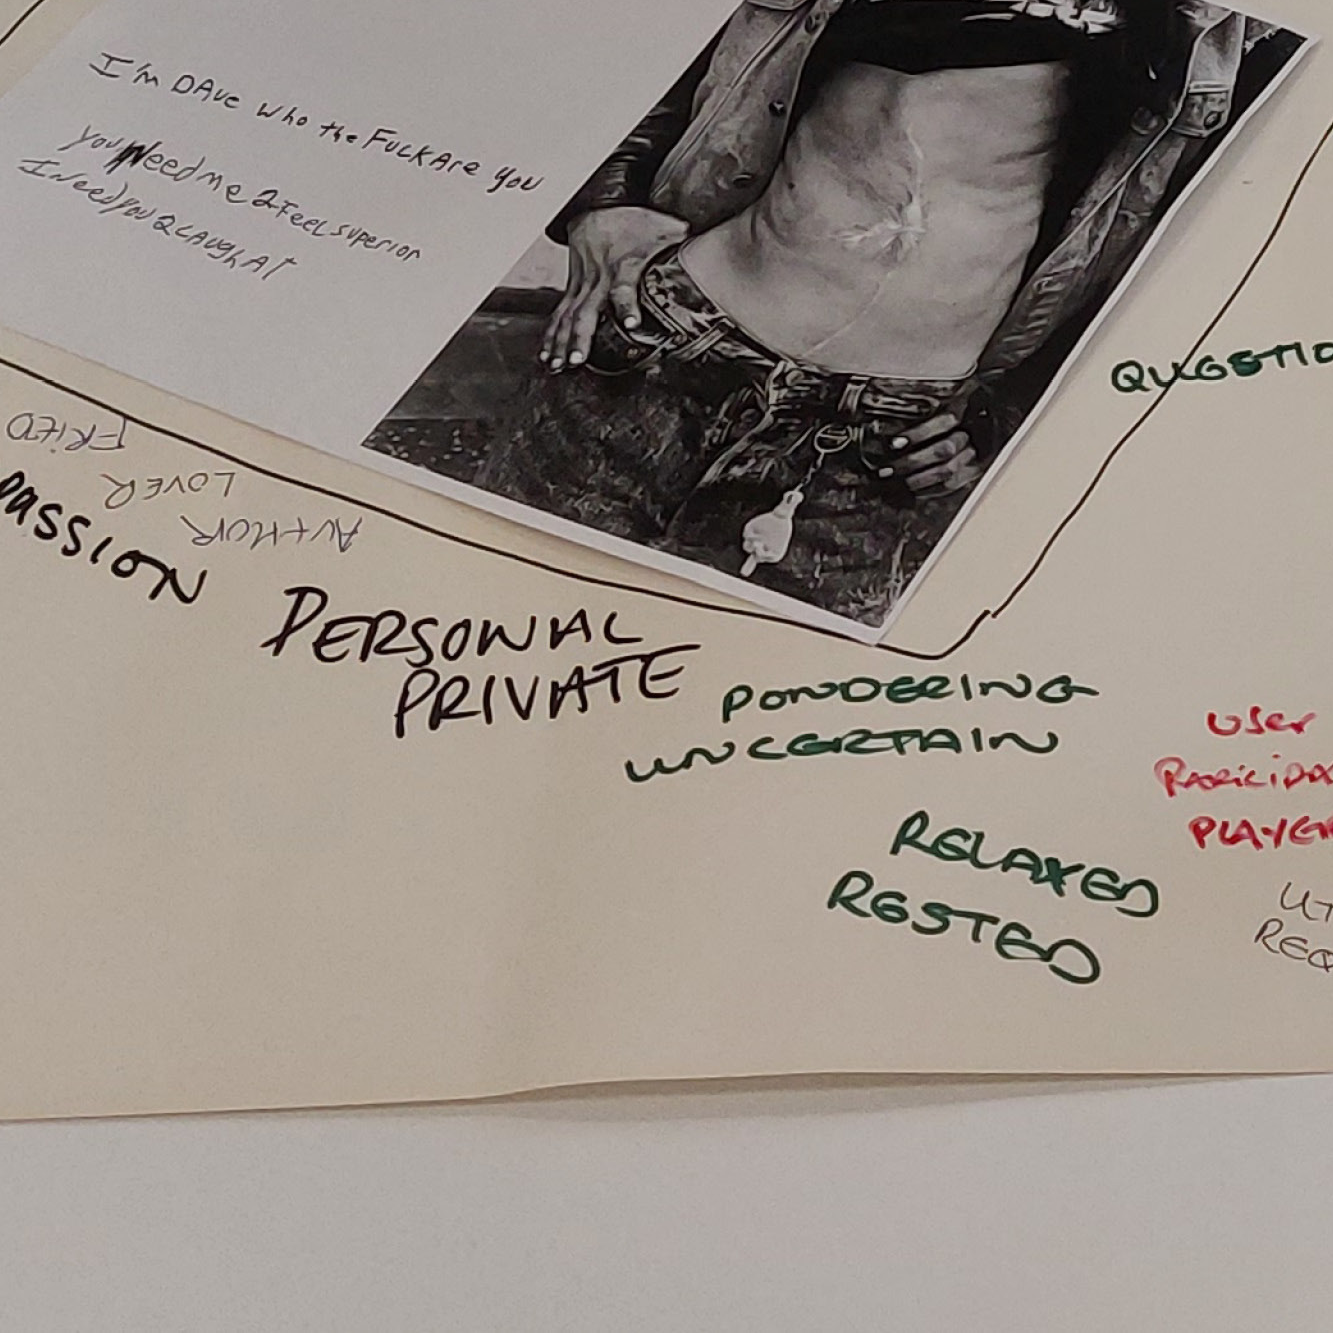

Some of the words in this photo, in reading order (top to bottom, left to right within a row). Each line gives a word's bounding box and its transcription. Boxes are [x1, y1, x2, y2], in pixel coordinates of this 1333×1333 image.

[100, 472, 235, 509] LOVER
[260, 585, 644, 668] PERSONAL
[394, 643, 701, 738] PRIVATE
[890, 810, 1160, 919] RELAXED
[827, 870, 1101, 985] RESTED
